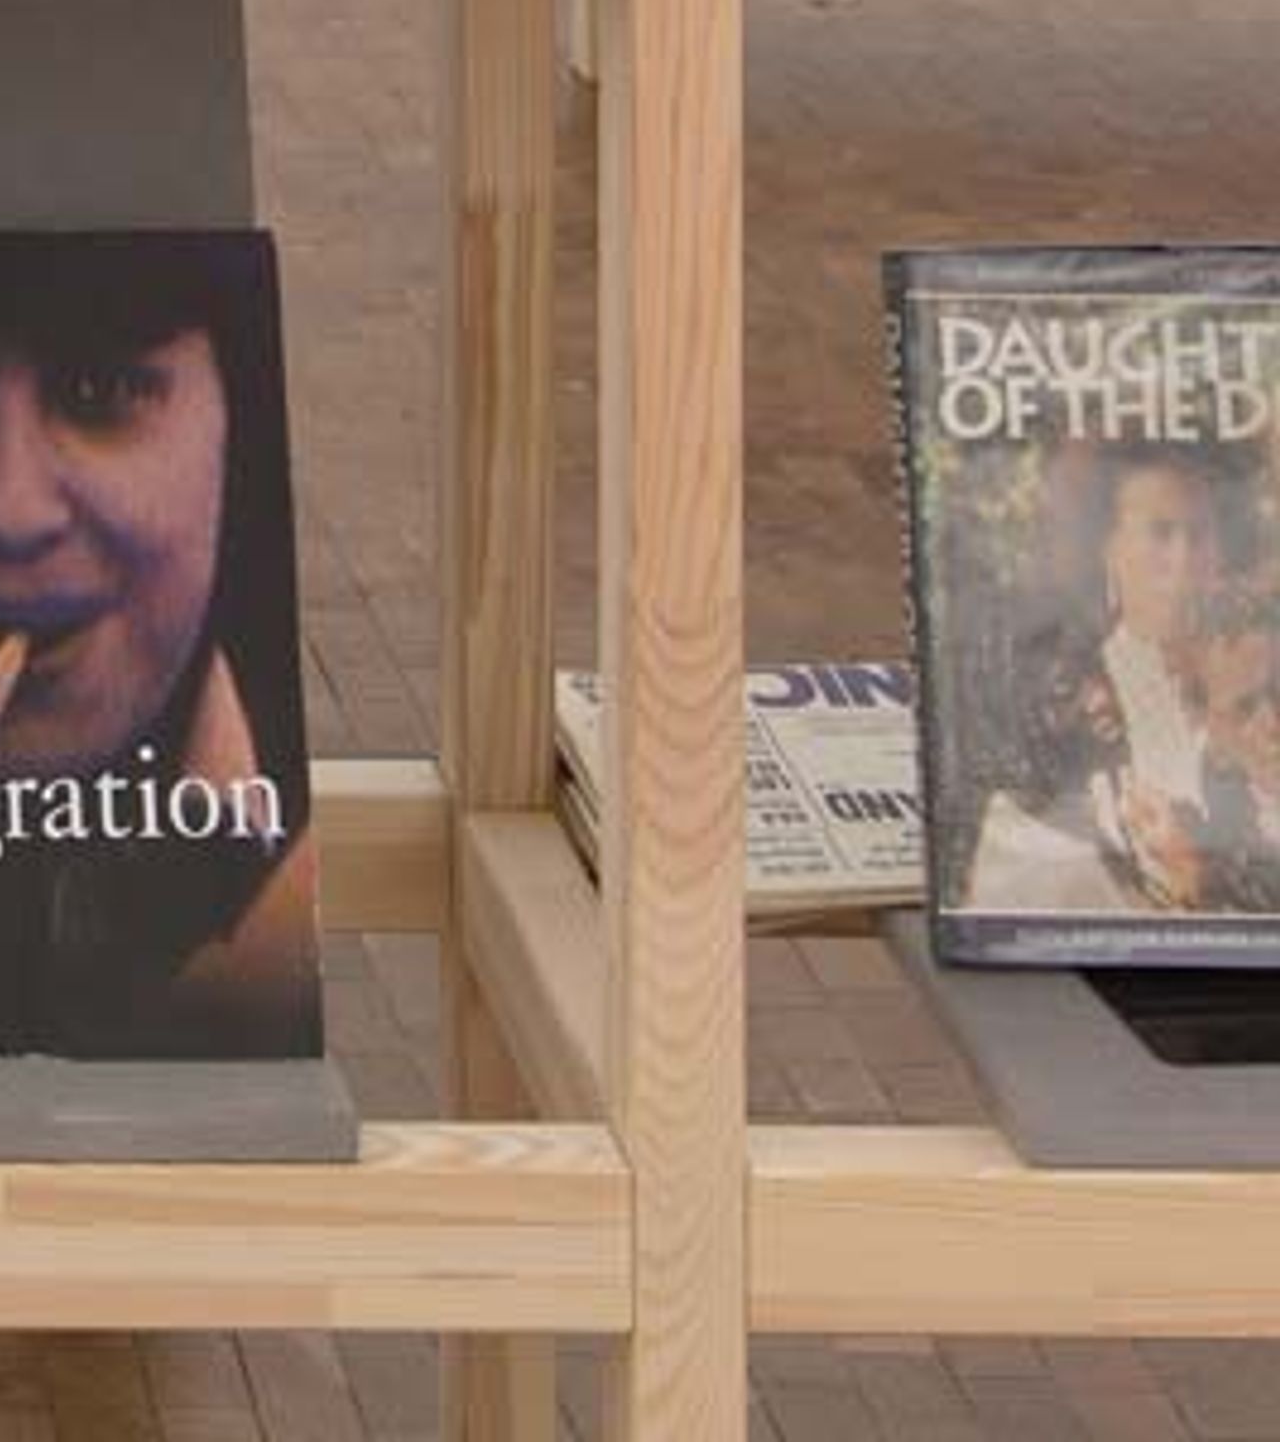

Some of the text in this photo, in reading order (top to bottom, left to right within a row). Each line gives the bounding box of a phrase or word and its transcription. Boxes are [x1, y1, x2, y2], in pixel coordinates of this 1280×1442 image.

[939, 315, 1280, 383] DAUGHT
[940, 377, 1039, 439] OF
[1047, 379, 1199, 441] THE
